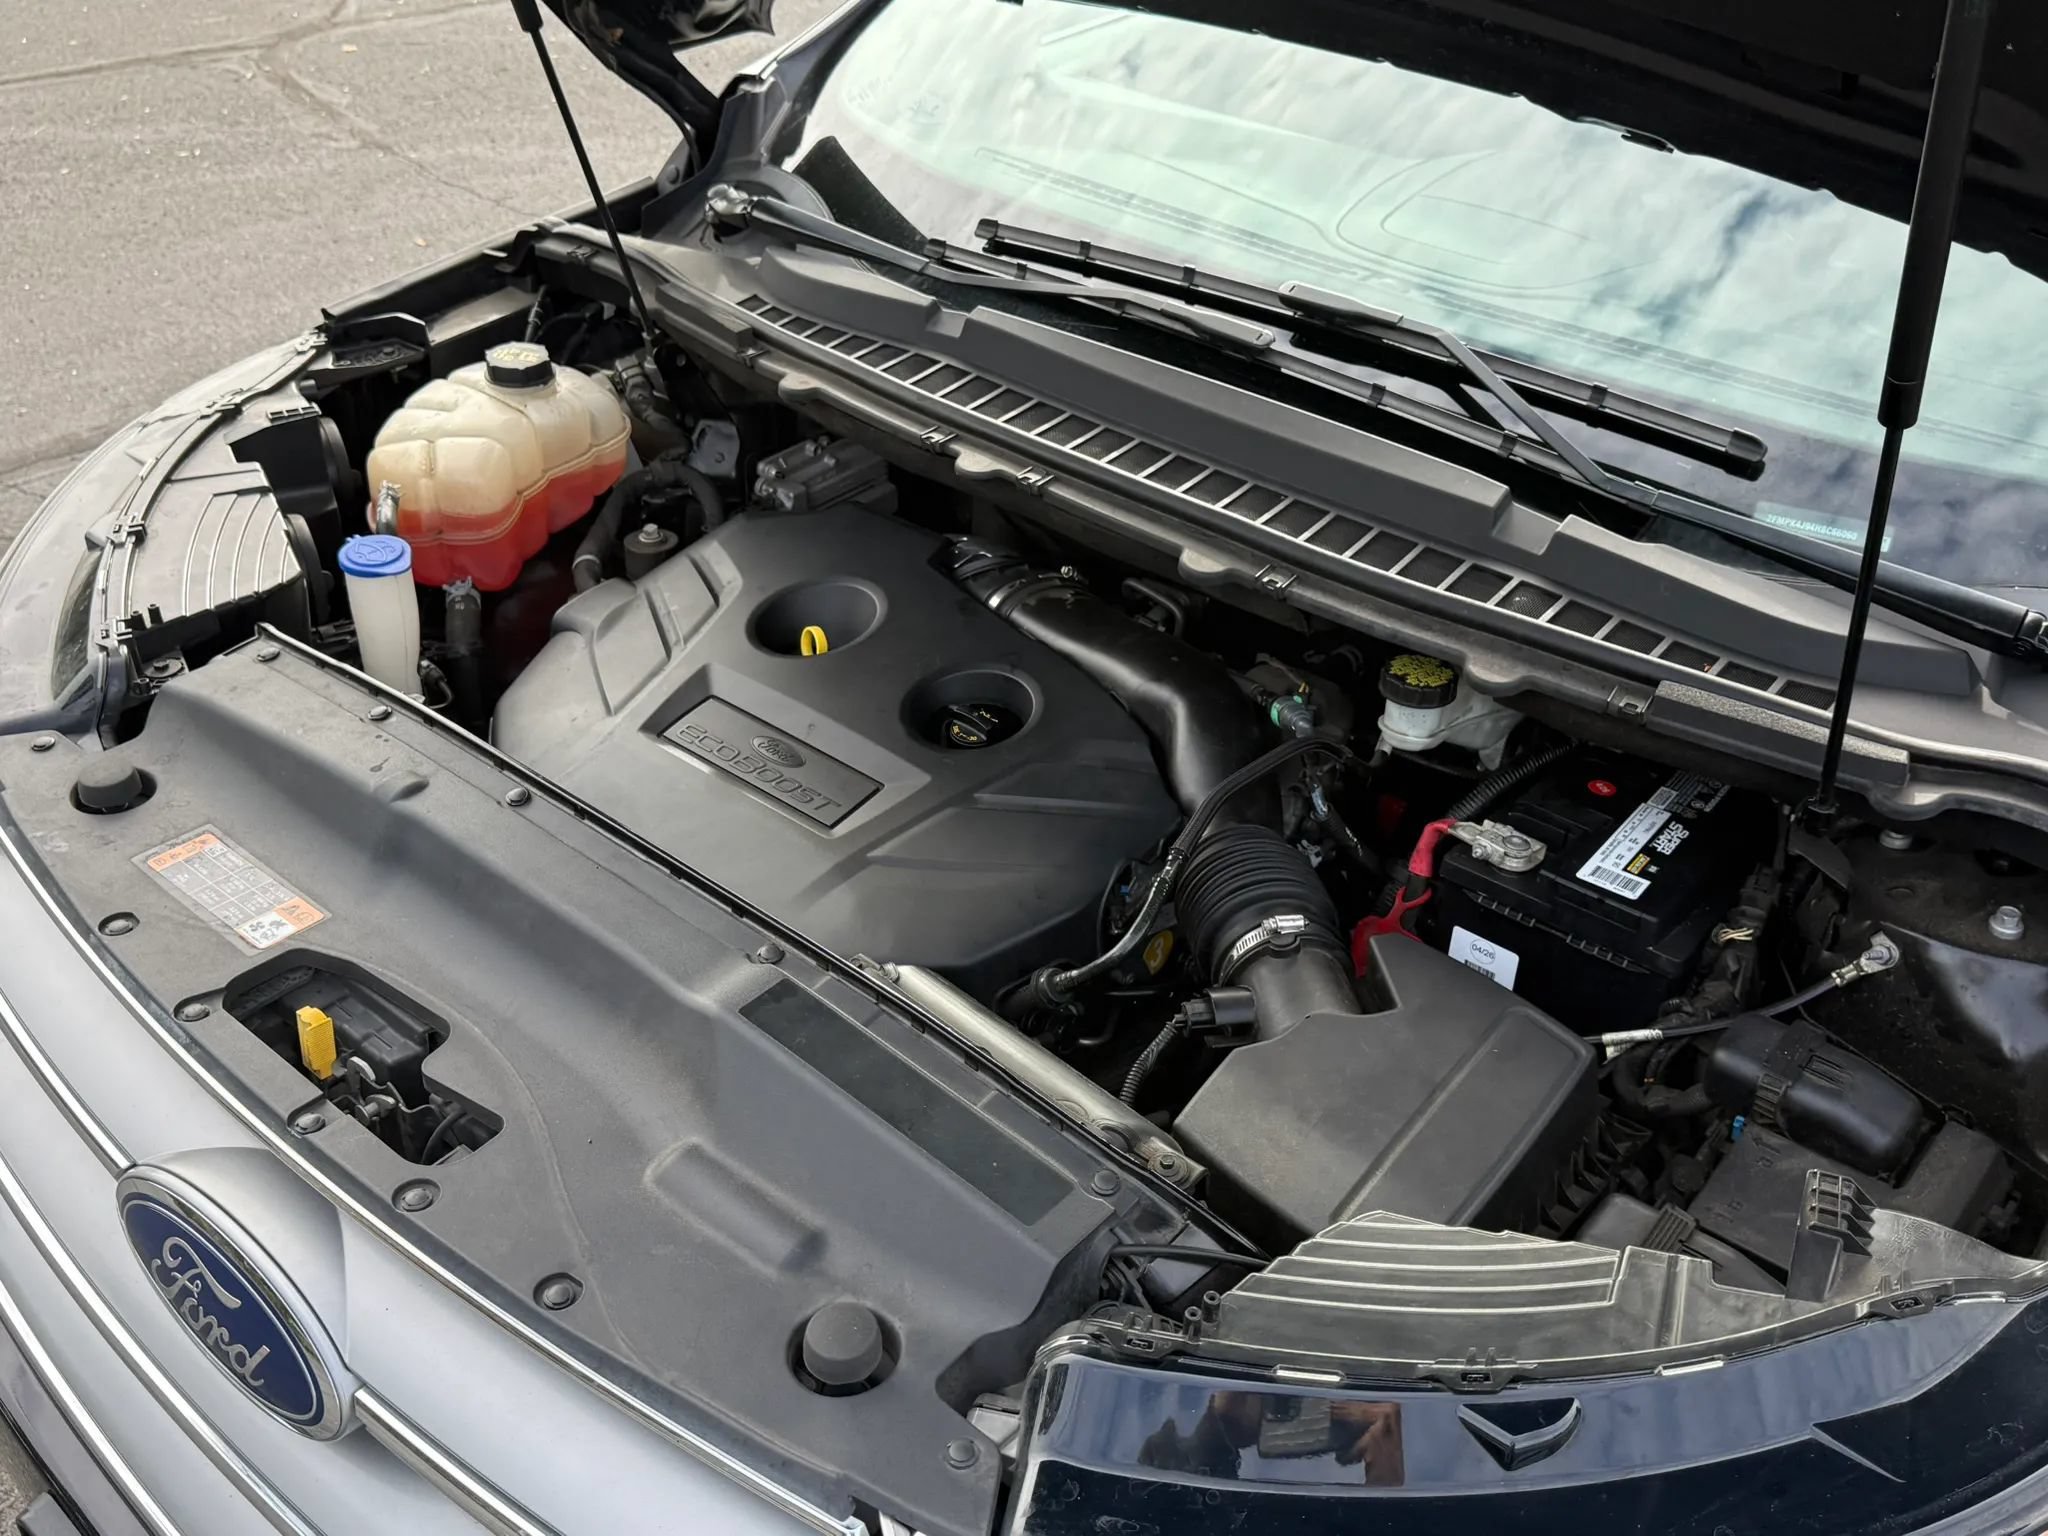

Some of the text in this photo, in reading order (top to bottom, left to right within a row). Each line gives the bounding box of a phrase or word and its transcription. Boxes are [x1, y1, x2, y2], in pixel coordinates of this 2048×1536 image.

[757, 737, 796, 765] Ford
[676, 723, 844, 811] ECOBOOST
[1651, 821, 1685, 852] START
[1661, 827, 1690, 856] SUPER
[1471, 943, 1496, 960] 04/26
[151, 1236, 271, 1386] Ford
